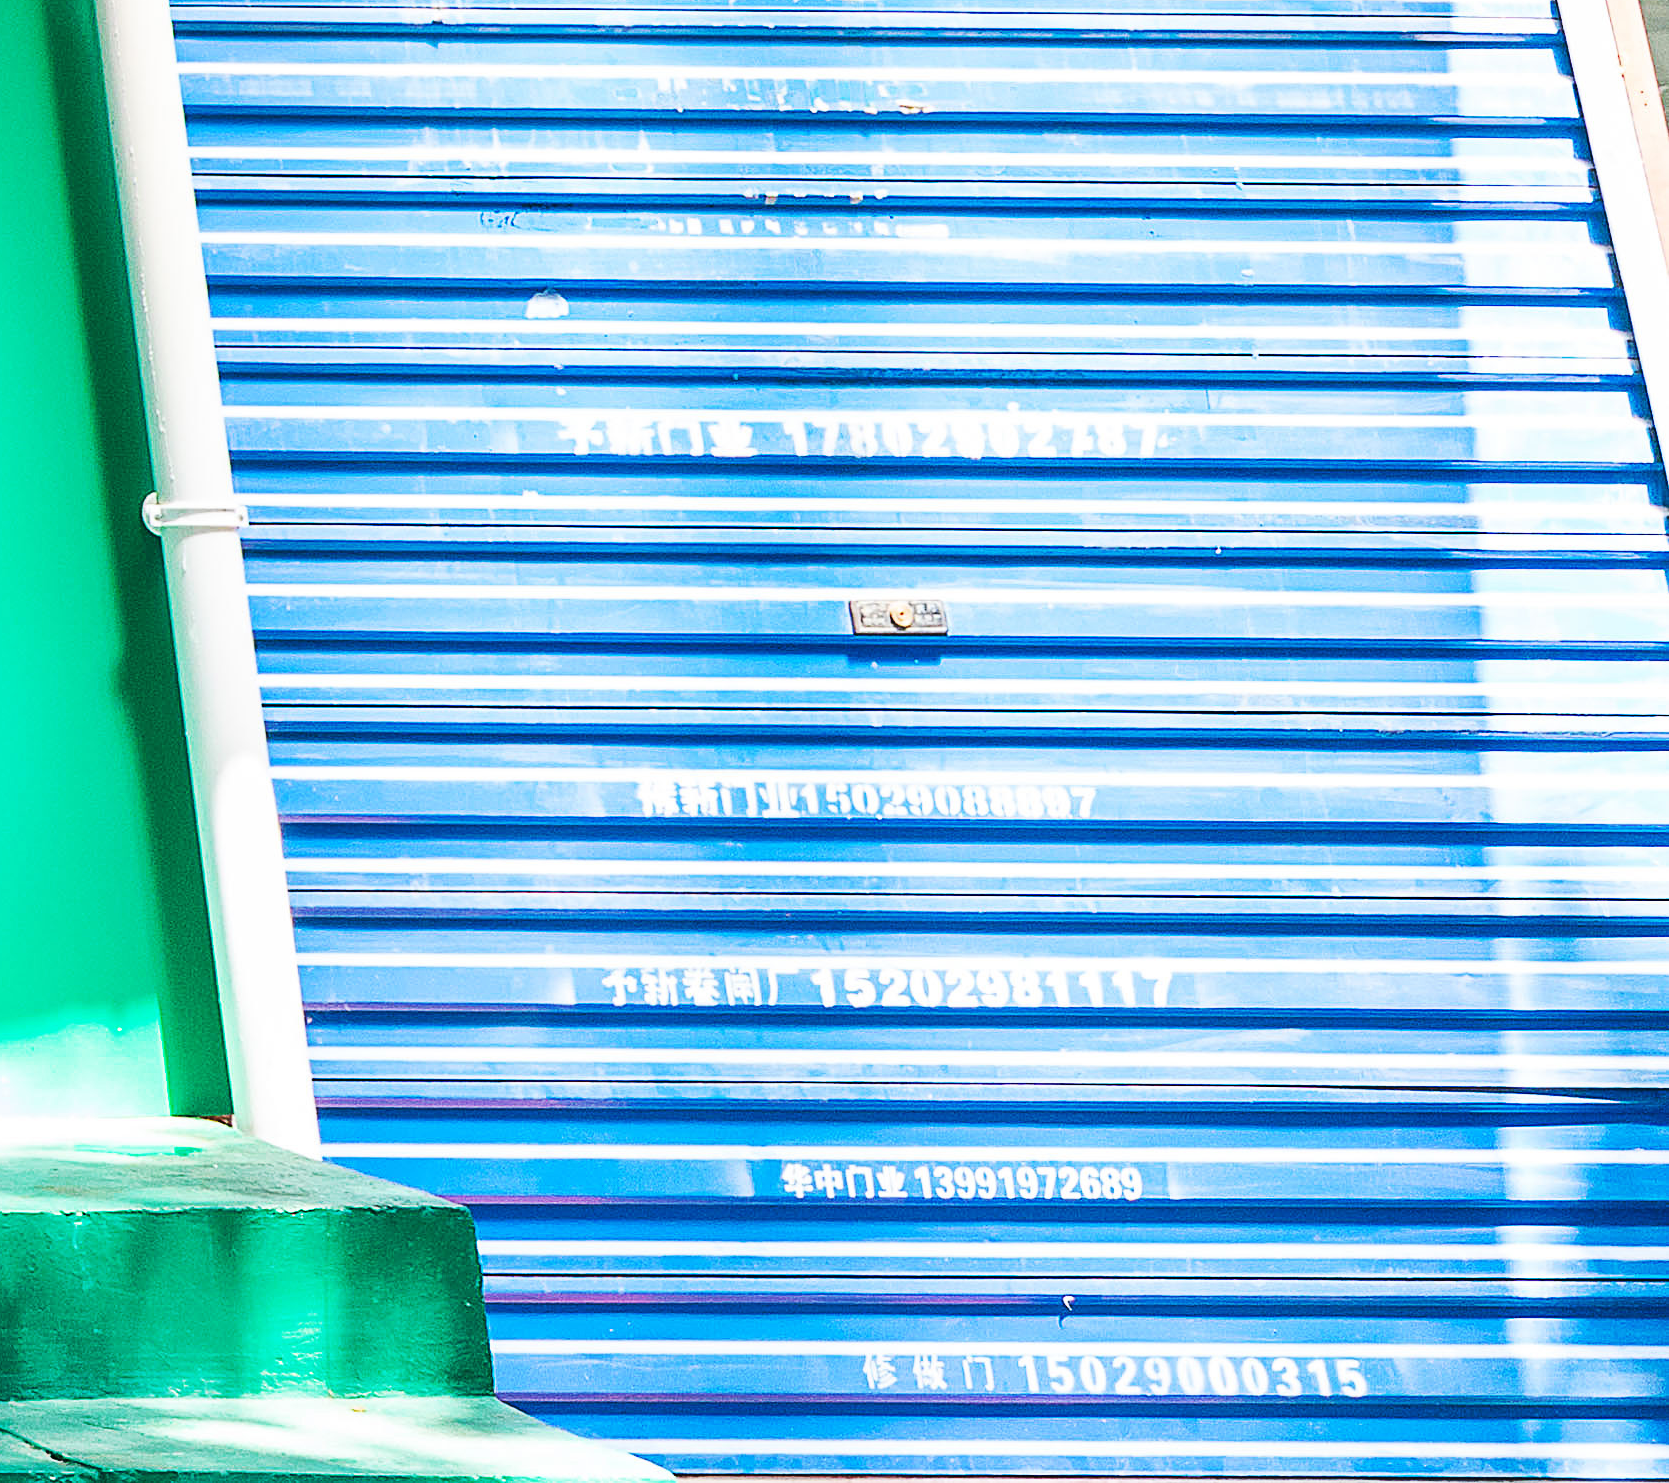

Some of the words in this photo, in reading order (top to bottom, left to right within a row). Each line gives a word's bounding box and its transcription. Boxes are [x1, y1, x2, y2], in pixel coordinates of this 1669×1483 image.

[780, 1163, 910, 1200] 华中门业
[912, 1165, 1145, 1202] 13991972689
[1016, 1356, 1370, 1399] 15029000315
